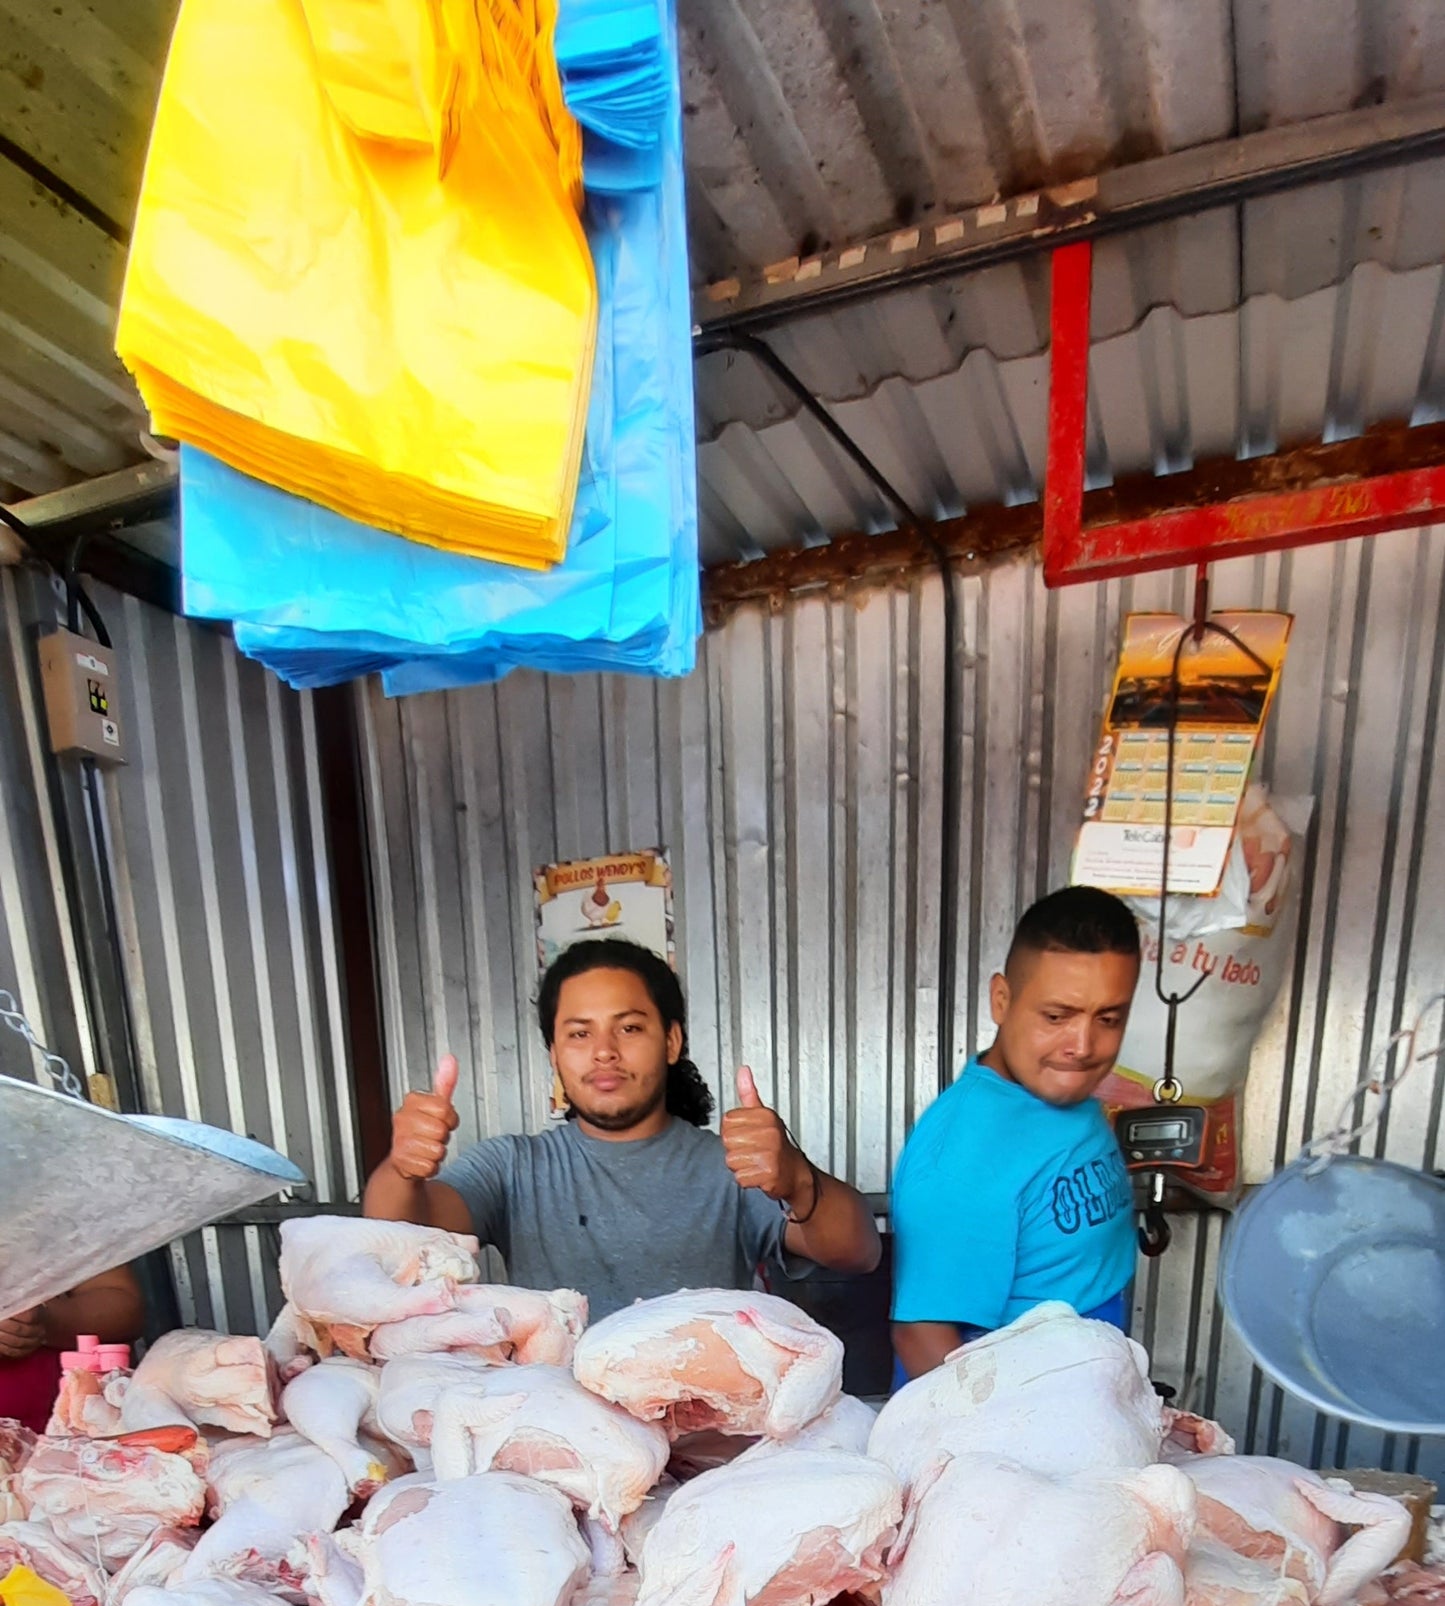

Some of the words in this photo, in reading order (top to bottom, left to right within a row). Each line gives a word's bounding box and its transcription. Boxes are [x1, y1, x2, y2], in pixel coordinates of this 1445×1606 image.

[1084, 734, 1114, 818] 2022
[553, 867, 594, 886] POLLOS
[596, 861, 647, 878] WENDY'S
[1170, 942, 1188, 964] a
[1192, 942, 1218, 974] tu
[1222, 954, 1260, 985] lado
